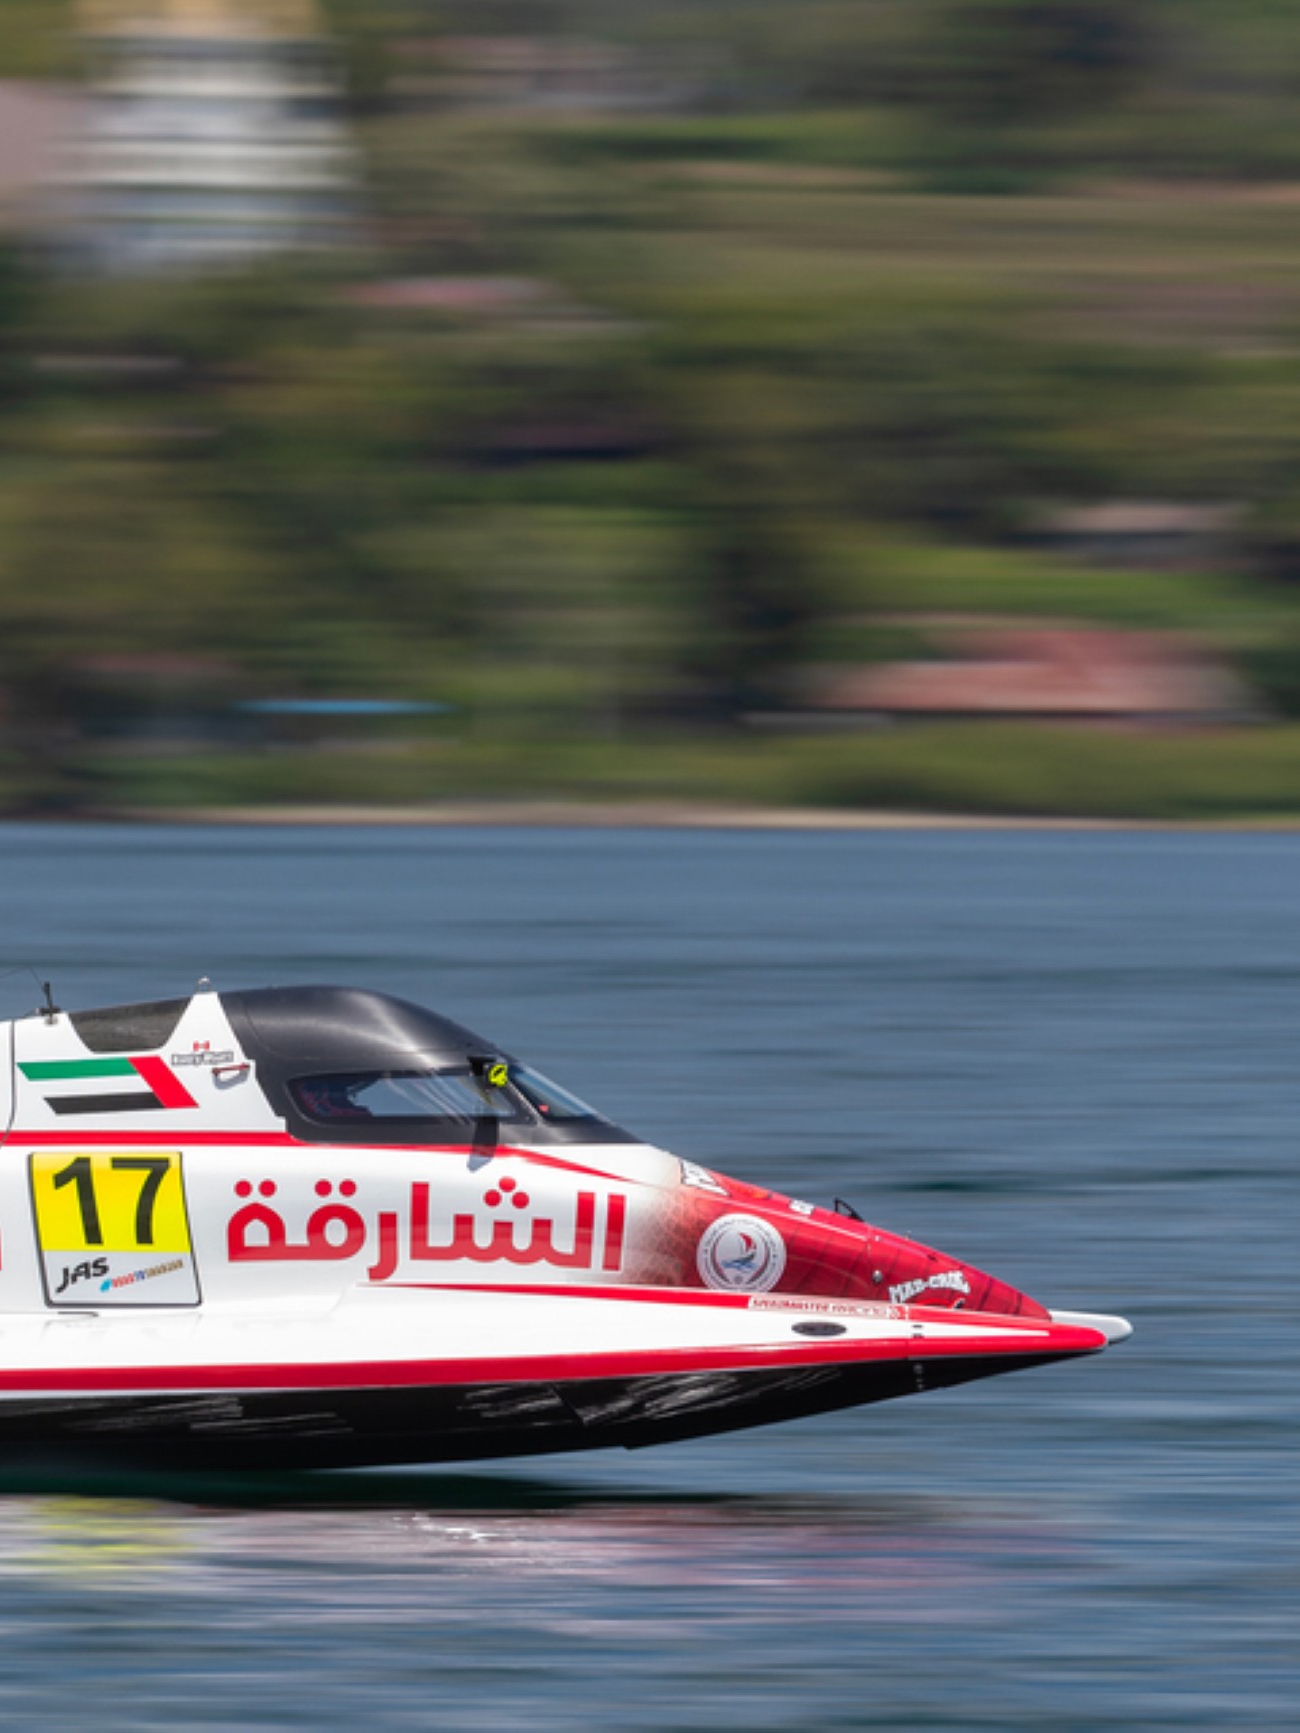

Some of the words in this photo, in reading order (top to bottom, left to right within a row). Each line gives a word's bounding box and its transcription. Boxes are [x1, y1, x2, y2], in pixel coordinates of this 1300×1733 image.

[53, 1157, 171, 1245] 17
[226, 1176, 627, 1282] الشارقة
[56, 1257, 109, 1293] JAS
